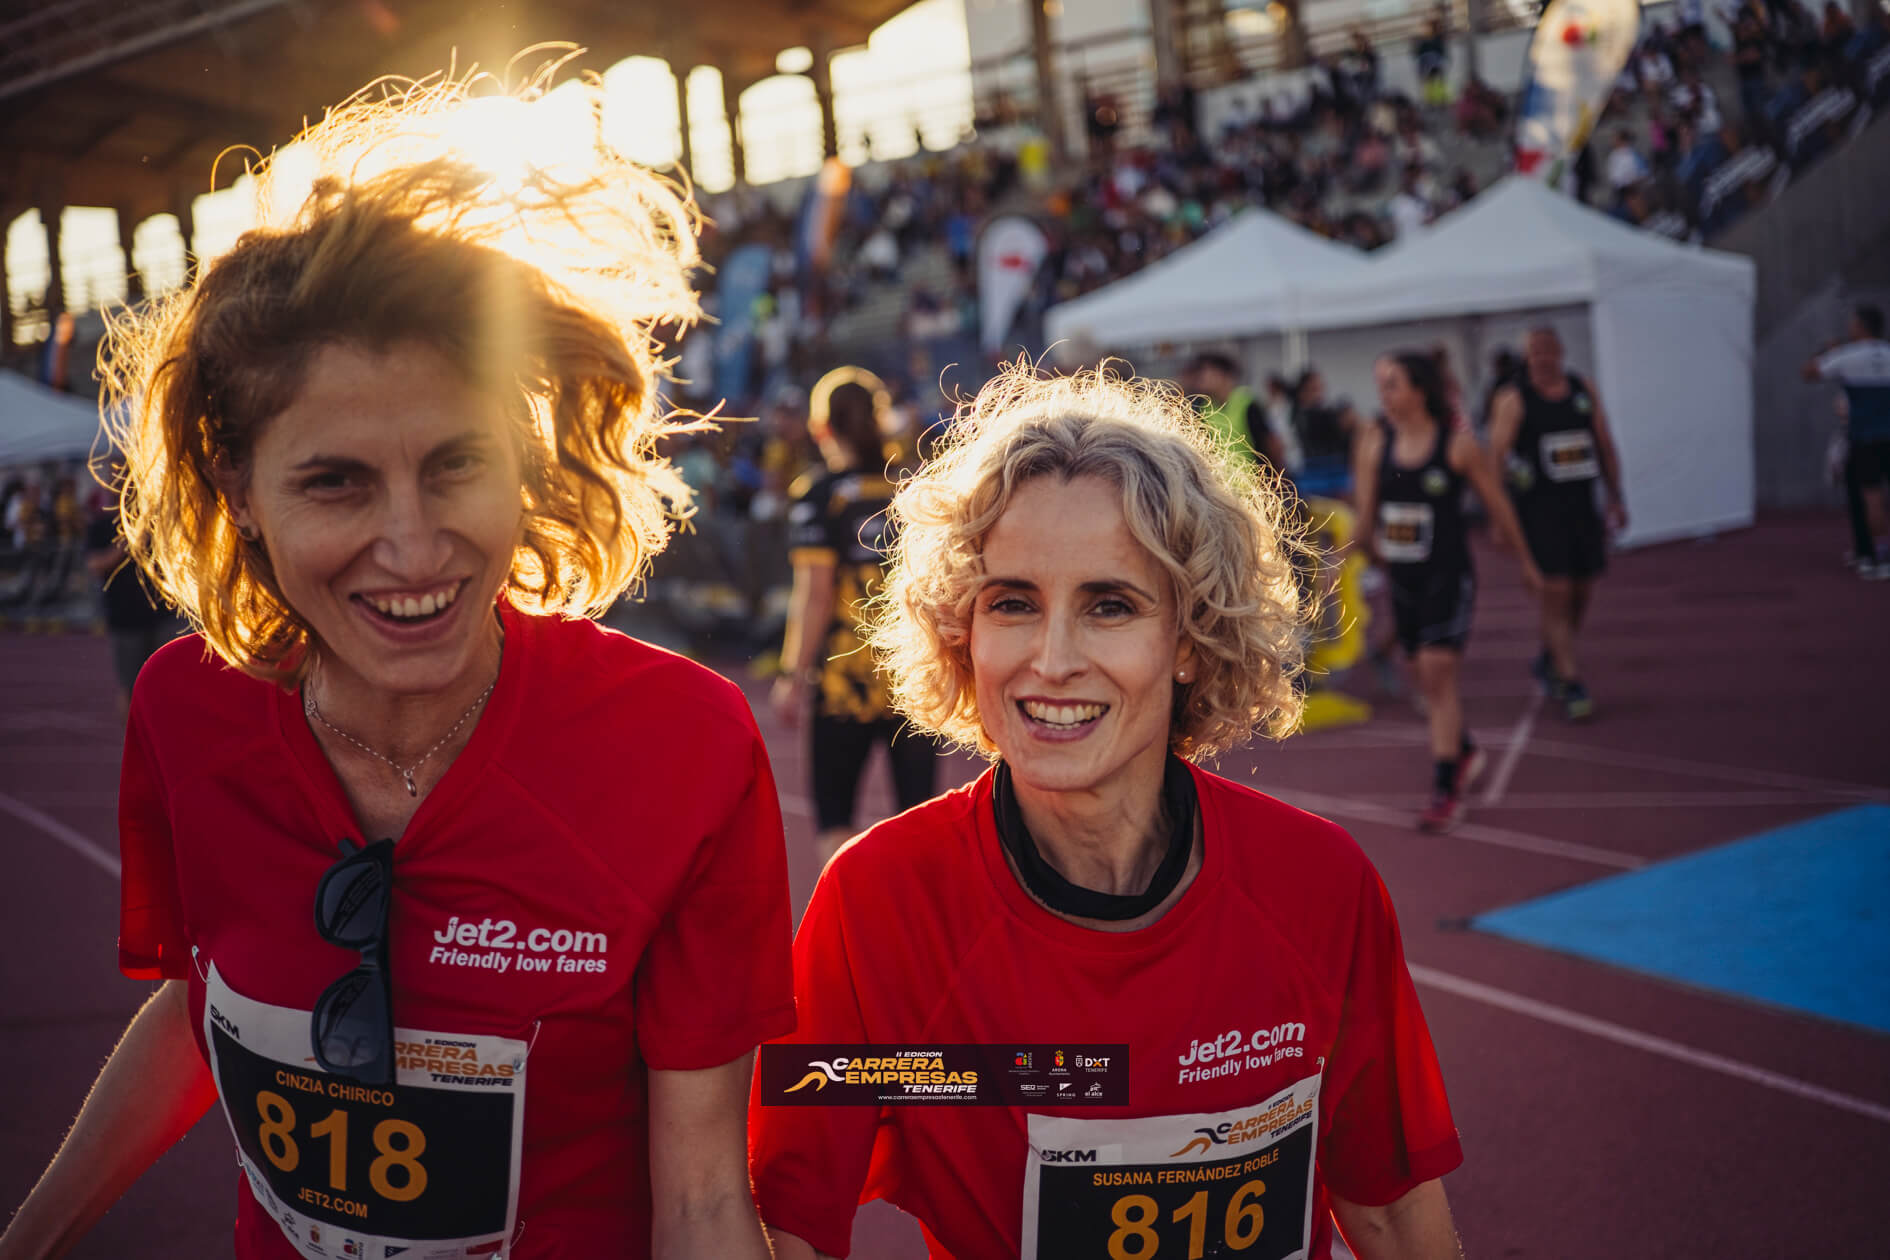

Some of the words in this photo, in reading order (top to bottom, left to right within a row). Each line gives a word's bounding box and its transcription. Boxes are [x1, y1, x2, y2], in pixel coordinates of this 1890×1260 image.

[429, 946, 511, 973] Friendly
[515, 954, 552, 972] low
[556, 955, 607, 973] fares
[394, 1040, 479, 1062] RRERA
[395, 1055, 515, 1077] MPRESAS
[1178, 1059, 1241, 1084] Friendly
[1245, 1054, 1273, 1070] low
[1274, 1046, 1304, 1063] fares
[275, 1070, 324, 1095] CINZIA
[327, 1083, 395, 1107] CHIRICO
[430, 1073, 514, 1087] TENERIFE
[1216, 1096, 1295, 1134] CARRERA
[1227, 1099, 1313, 1145] EMPRESAS
[1270, 1110, 1313, 1139] TENERIFE
[256, 1090, 428, 1202] 818
[1093, 1171, 1154, 1186] SUSANA
[1157, 1163, 1241, 1184] FERNÁNDEZ
[1243, 1148, 1280, 1175] ROBLE
[297, 1187, 369, 1219] JET2.COM
[1107, 1179, 1266, 1260] 816
